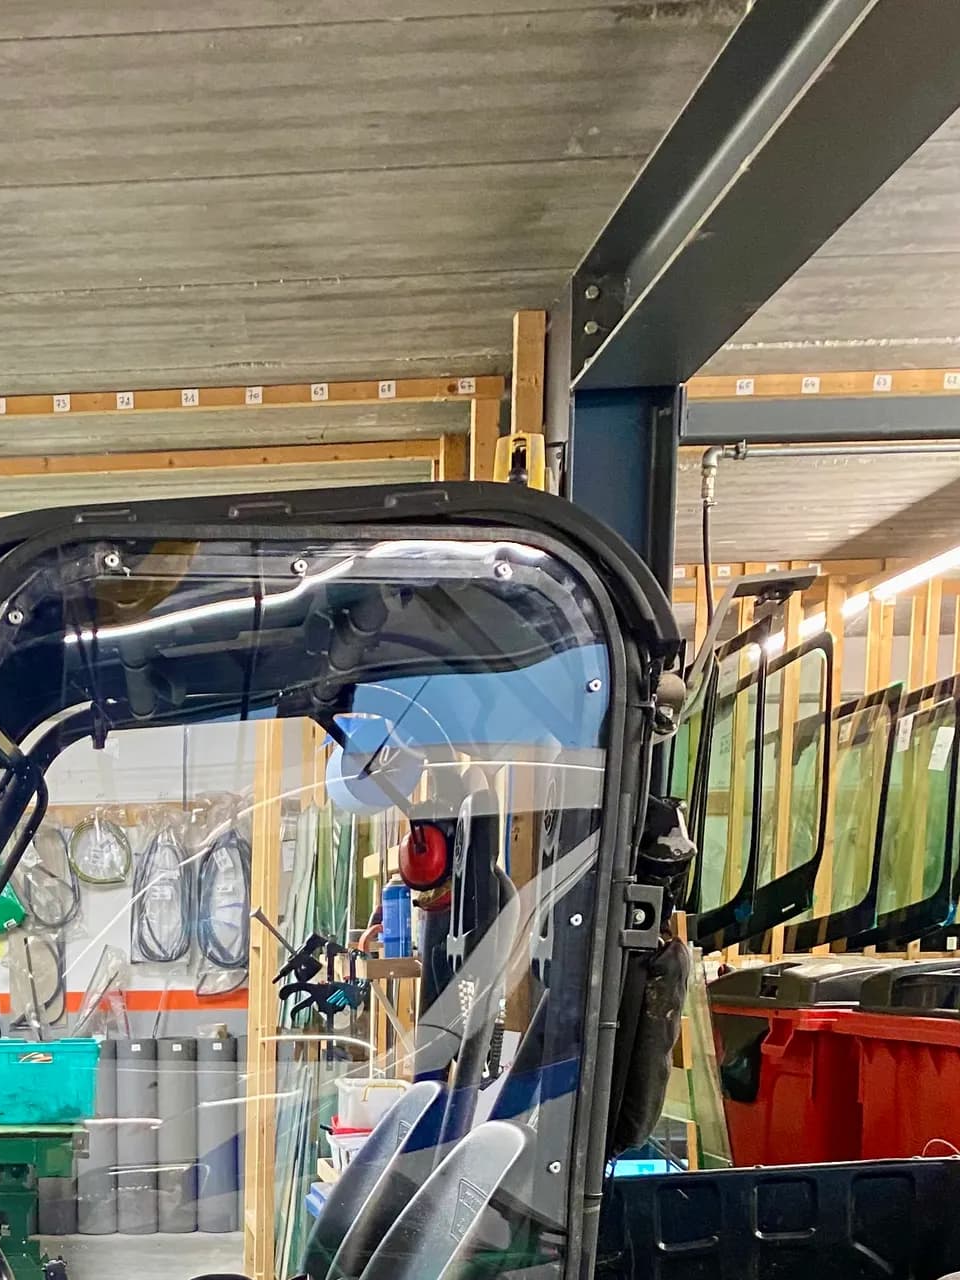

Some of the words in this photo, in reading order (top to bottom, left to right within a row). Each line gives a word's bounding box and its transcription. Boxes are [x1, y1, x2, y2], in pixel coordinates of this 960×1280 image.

[459, 379, 473, 390] 67
[183, 392, 195, 403] 71
[247, 389, 260, 400] 70
[313, 387, 325, 397] 69
[55, 399, 67, 409] 73
